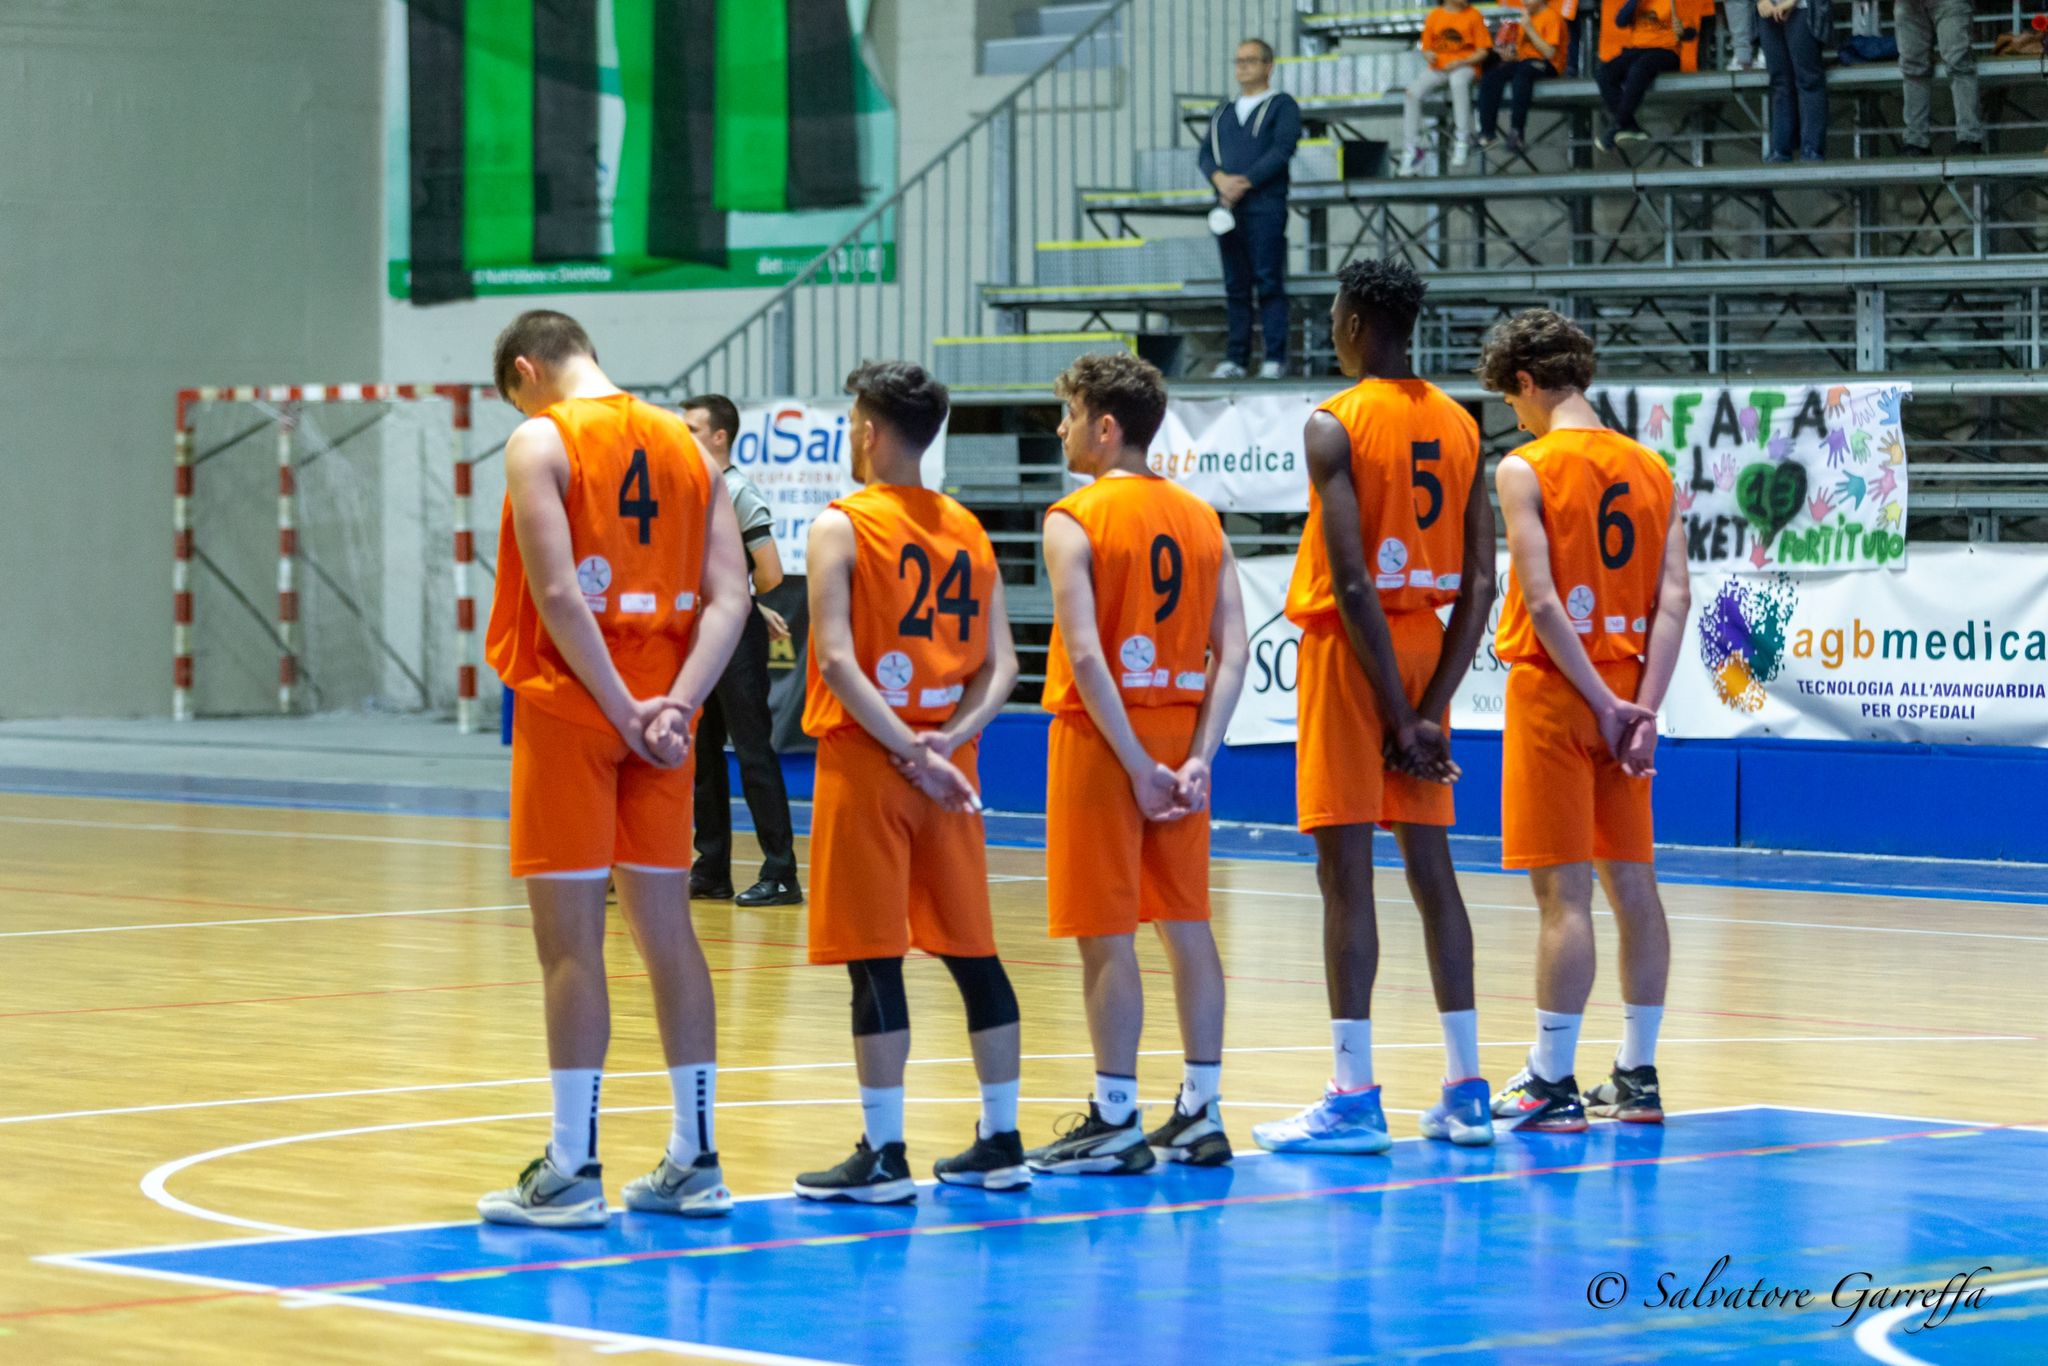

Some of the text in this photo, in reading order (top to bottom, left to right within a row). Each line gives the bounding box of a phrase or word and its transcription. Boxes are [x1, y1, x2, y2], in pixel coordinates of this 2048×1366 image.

[619, 449, 659, 544] 4
[1411, 439, 1444, 531] 5
[1598, 482, 1634, 570] 6
[1151, 534, 1183, 624] 9
[1682, 514, 1749, 562] KET
[899, 543, 979, 641] 24
[1792, 619, 2047, 669] agbmedica
[1797, 679, 2046, 699] TECNOLOGIA ALL'AVANGUARDIA
[1861, 703, 1976, 720] PER OSPEDALI
